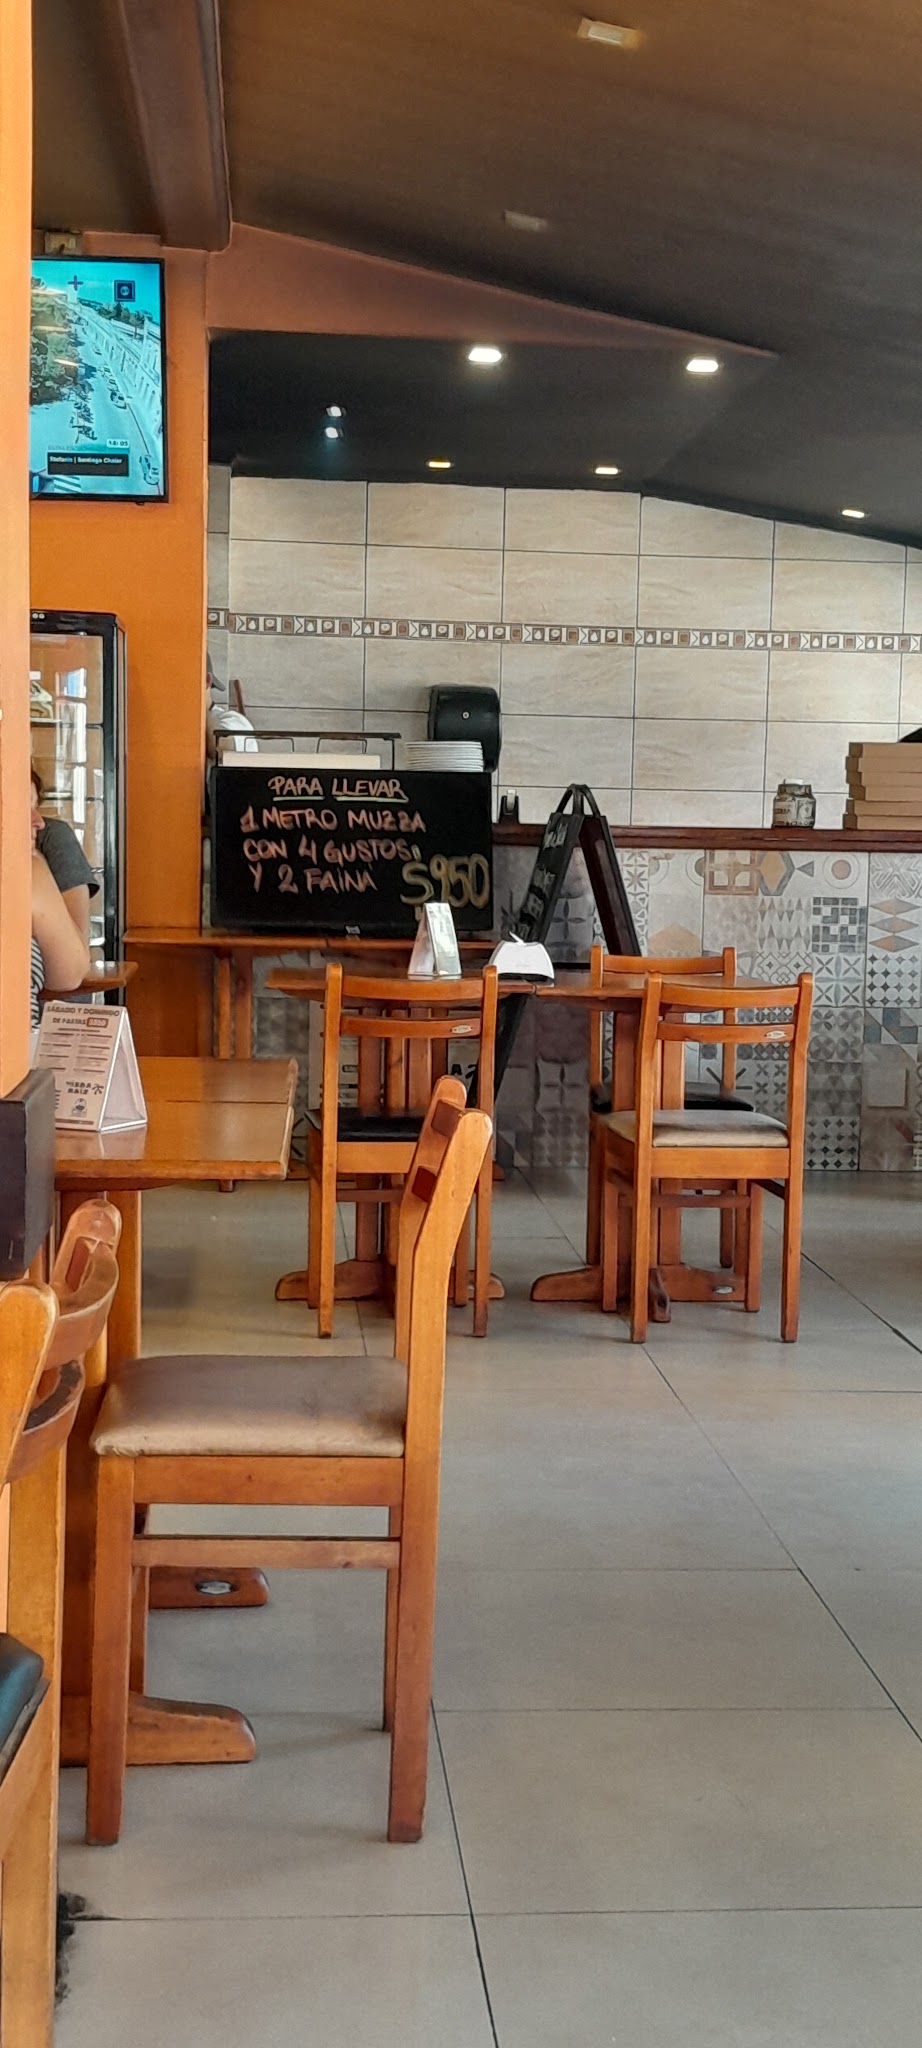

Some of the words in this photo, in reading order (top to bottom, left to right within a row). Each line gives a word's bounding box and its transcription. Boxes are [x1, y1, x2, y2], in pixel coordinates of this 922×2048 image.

[268, 775, 323, 796] PARA
[332, 777, 407, 798] LLEVAR
[240, 804, 260, 833] 1
[262, 806, 337, 832] METRO
[347, 809, 427, 833] MUZZA
[243, 838, 288, 862] CON
[298, 834, 318, 865] 4
[323, 838, 413, 866] GUSTOS
[248, 862, 263, 893] Y
[277, 864, 299, 894] 2
[400, 846, 490, 918] $950
